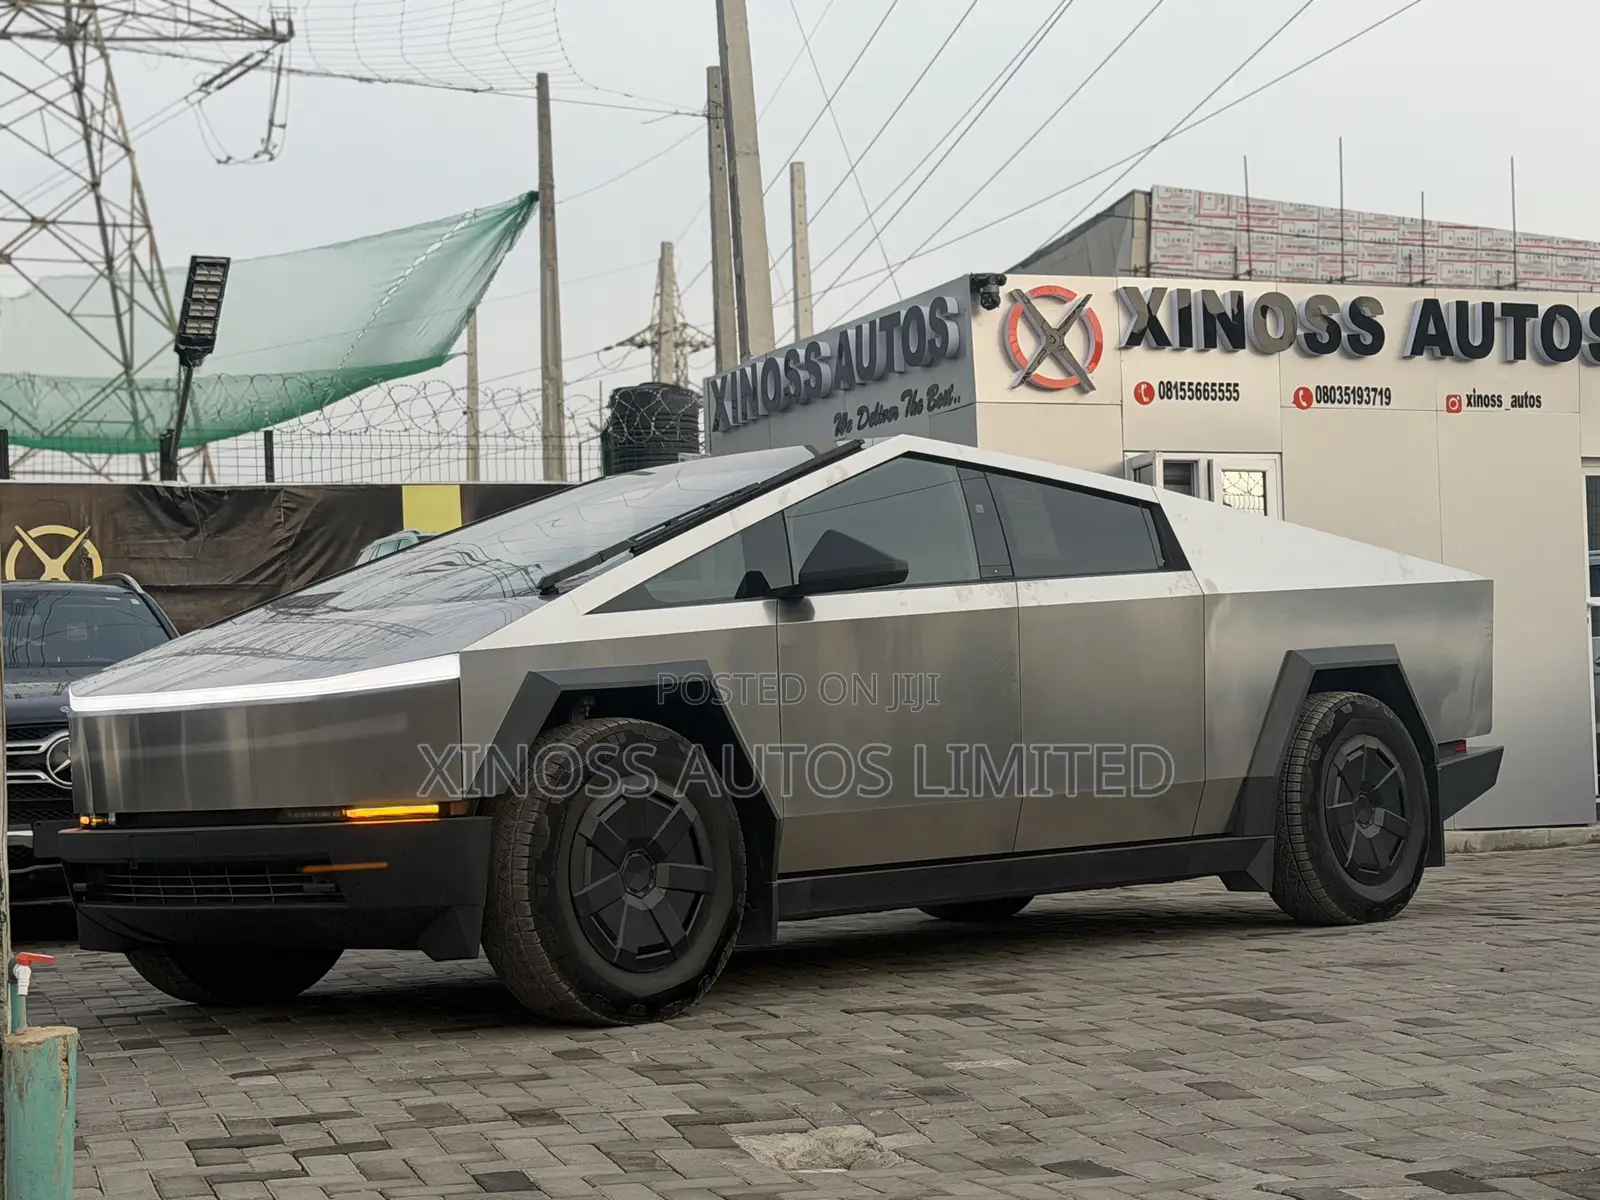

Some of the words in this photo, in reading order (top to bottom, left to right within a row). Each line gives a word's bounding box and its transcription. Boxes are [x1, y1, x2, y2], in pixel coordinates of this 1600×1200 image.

[1116, 286, 1386, 357] XINOSS
[710, 341, 831, 432] XINOSS
[834, 296, 959, 390] AUTOS
[833, 411, 853, 437] We
[857, 401, 899, 430] Deliver
[900, 389, 924, 418] The
[1158, 380, 1240, 402] 08155665555
[1315, 385, 1392, 406] 08035193719
